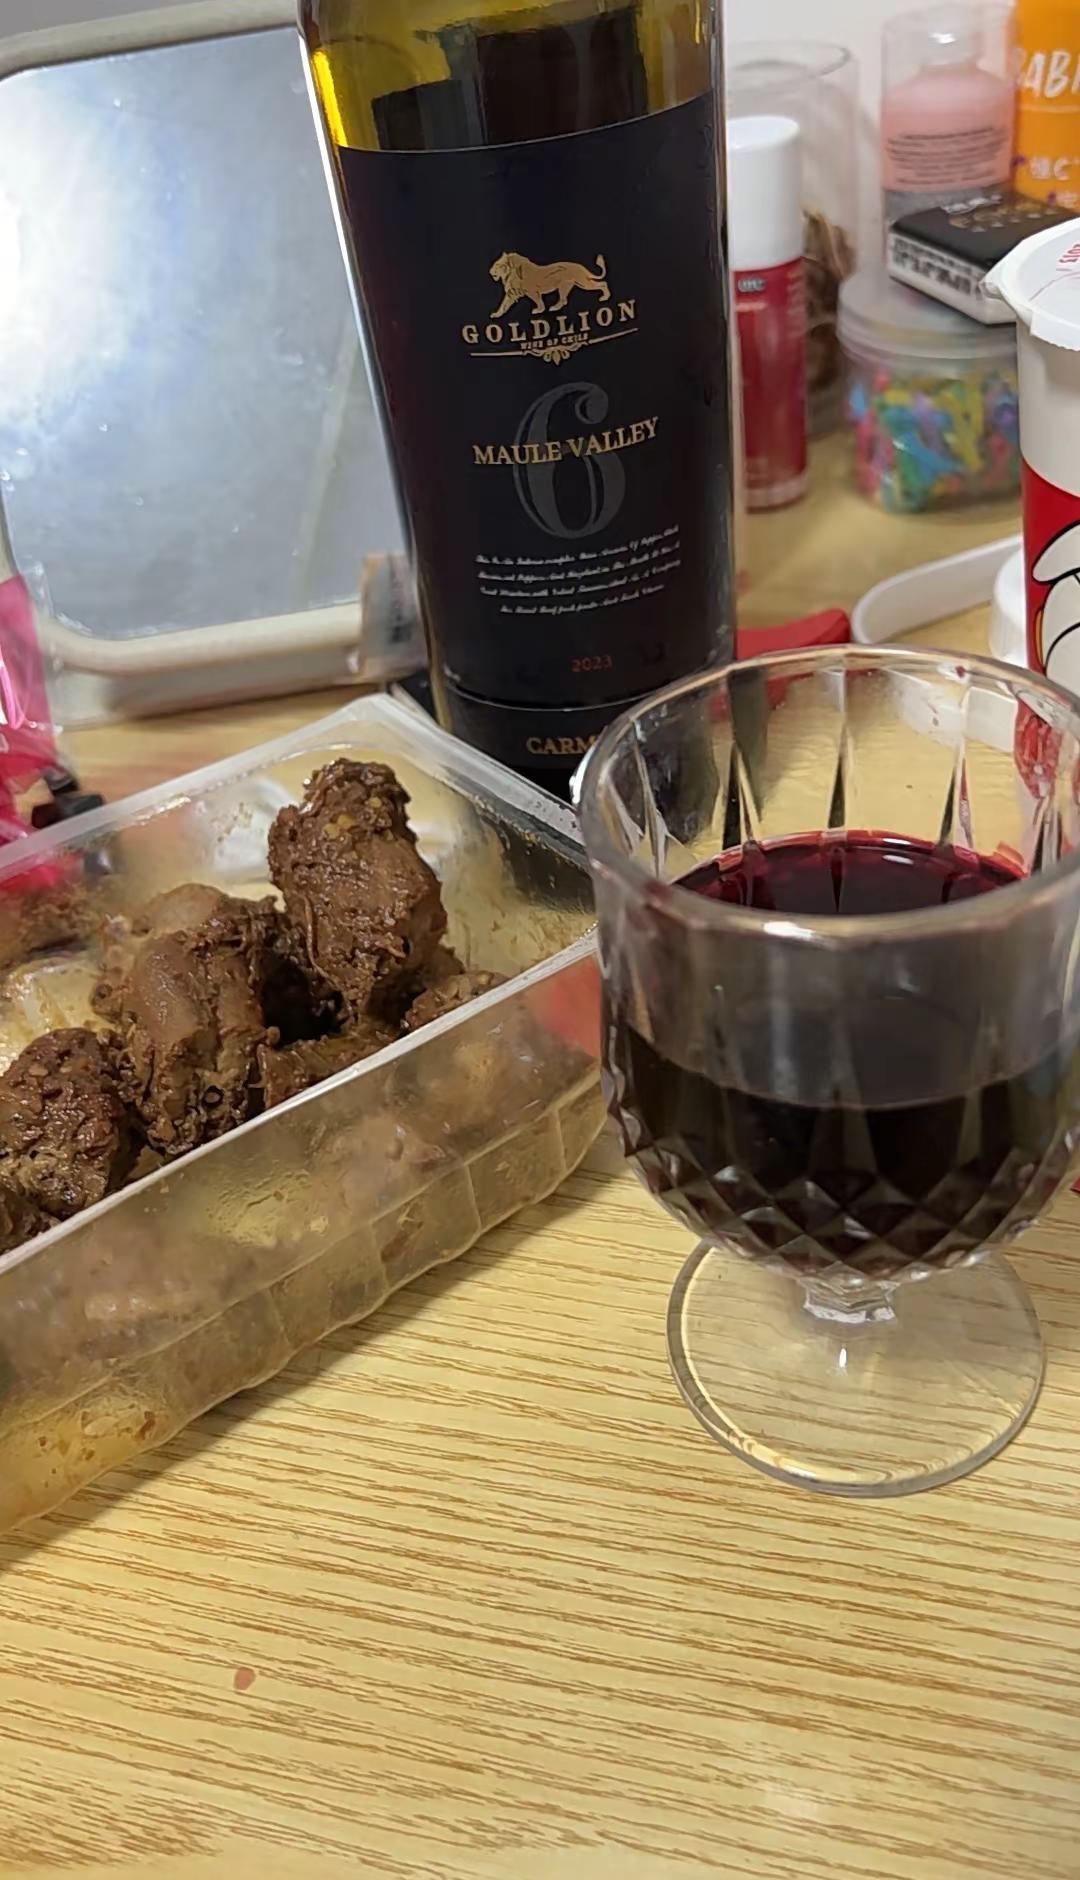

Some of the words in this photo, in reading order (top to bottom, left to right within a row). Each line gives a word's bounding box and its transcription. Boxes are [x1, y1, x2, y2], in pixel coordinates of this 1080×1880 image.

[462, 300, 637, 344] GOLDLION
[473, 441, 562, 465] MAULE
[567, 416, 659, 457] VALLEY
[571, 655, 613, 673] 2023
